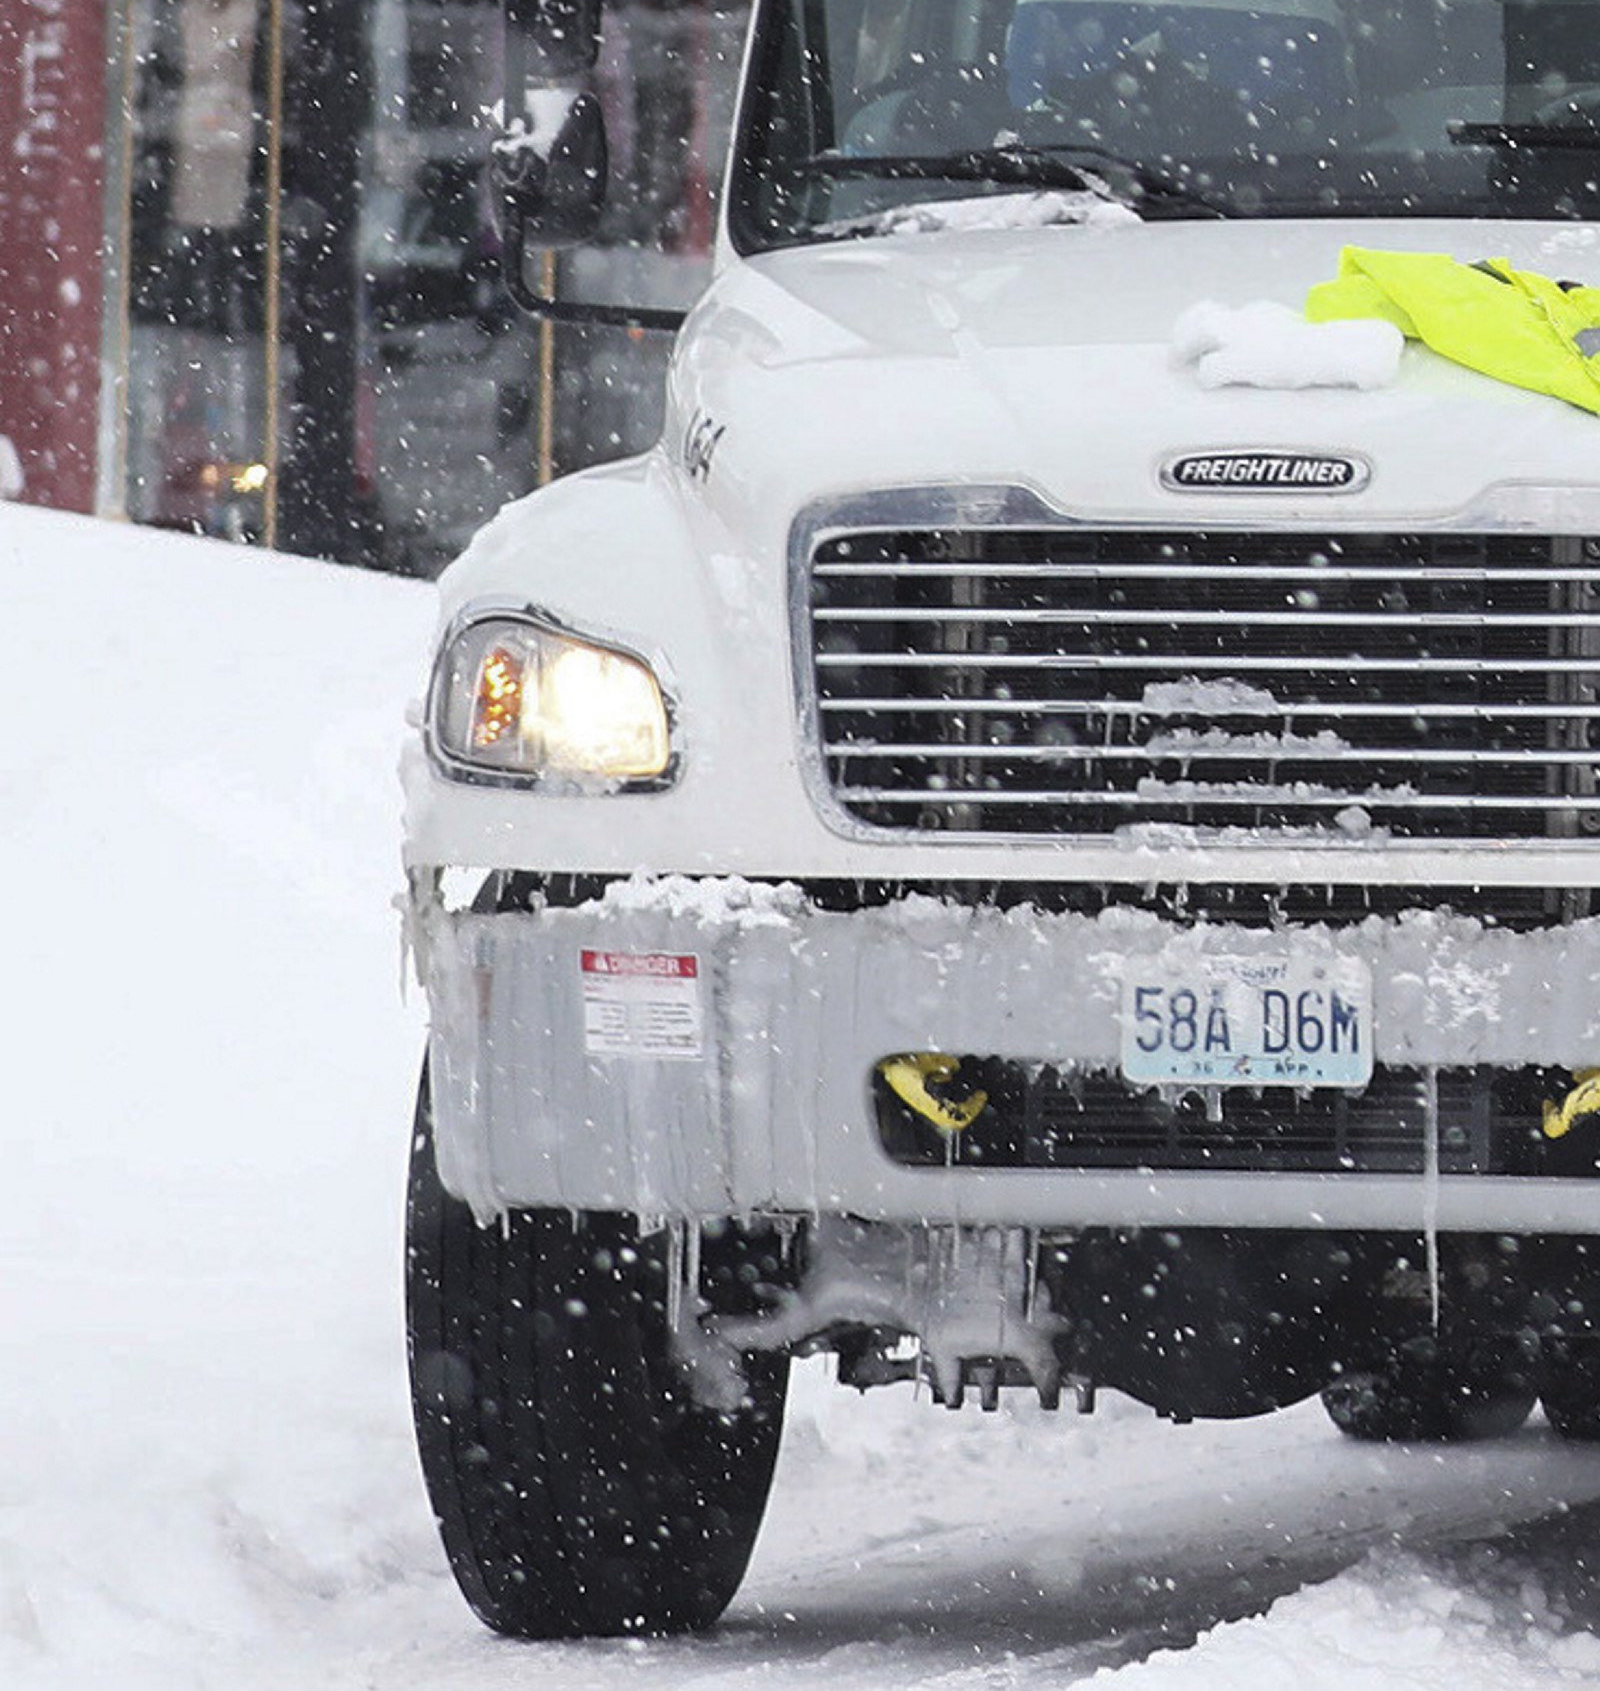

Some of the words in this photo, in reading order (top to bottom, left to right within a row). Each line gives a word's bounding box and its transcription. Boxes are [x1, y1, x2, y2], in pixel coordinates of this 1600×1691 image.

[1180, 459, 1347, 483] FREIGHTLINER
[1135, 986, 1231, 1053] 58A
[1263, 989, 1358, 1054] D6M
